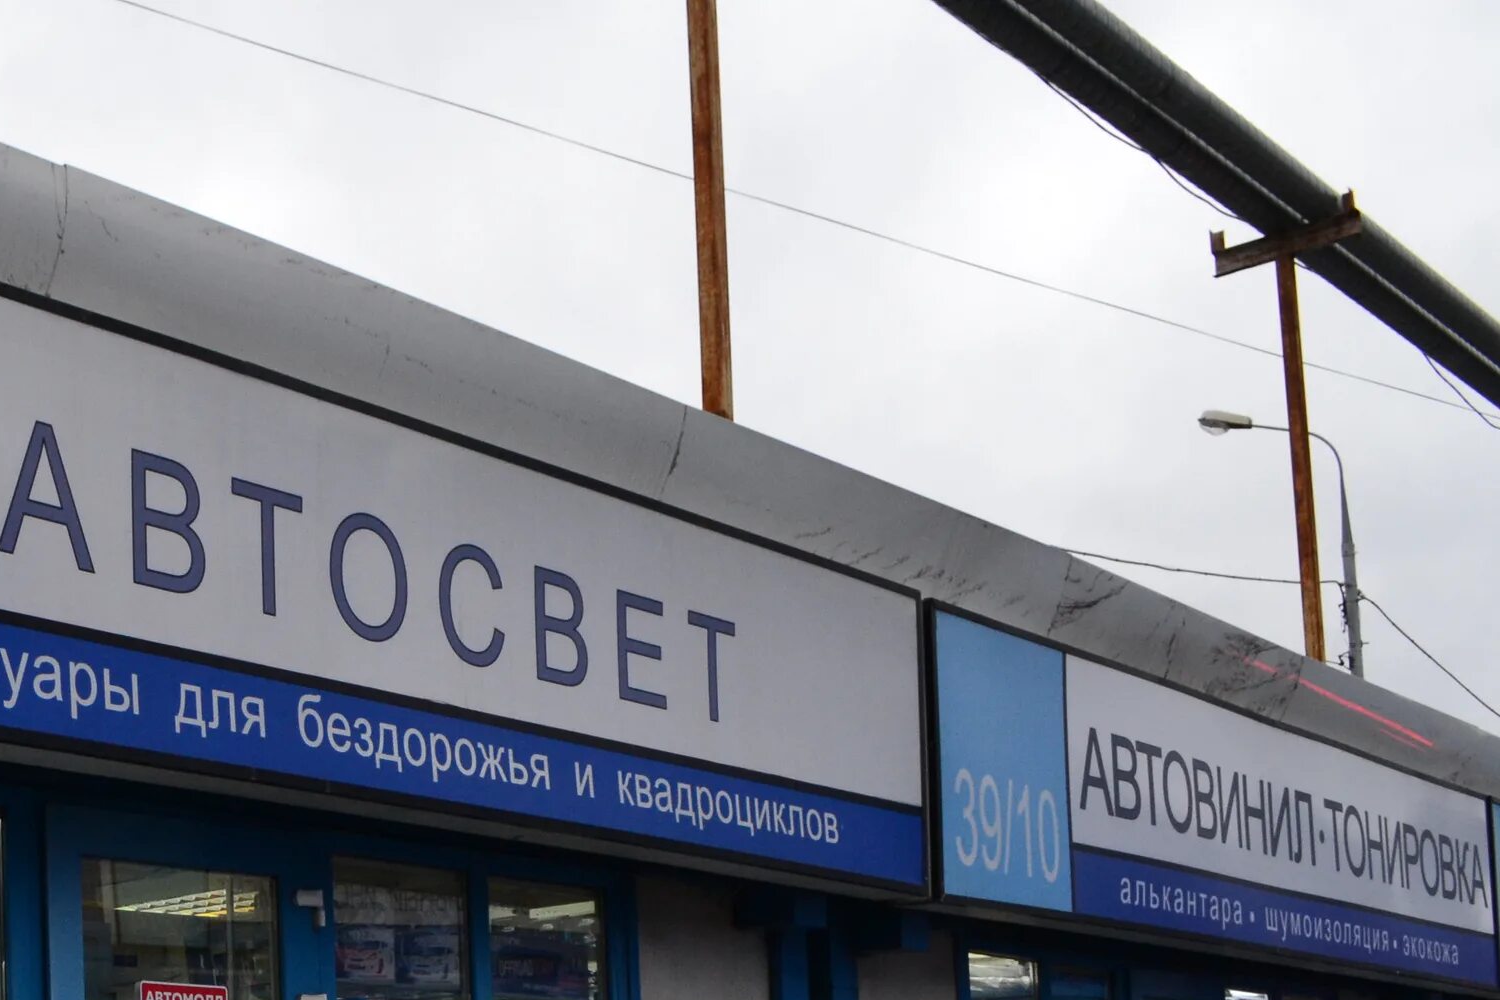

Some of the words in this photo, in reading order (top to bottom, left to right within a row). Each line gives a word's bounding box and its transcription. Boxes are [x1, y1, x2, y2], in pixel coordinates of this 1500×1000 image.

[173, 682, 267, 739] для
[296, 693, 551, 791] бездорожья
[574, 761, 595, 799] и
[616, 769, 840, 845] квадроциклов
[954, 766, 1061, 884] 39/10
[1119, 874, 1244, 929] алькантара
[1264, 905, 1390, 955] шумоизоляция
[1401, 937, 1460, 966] экокожа
